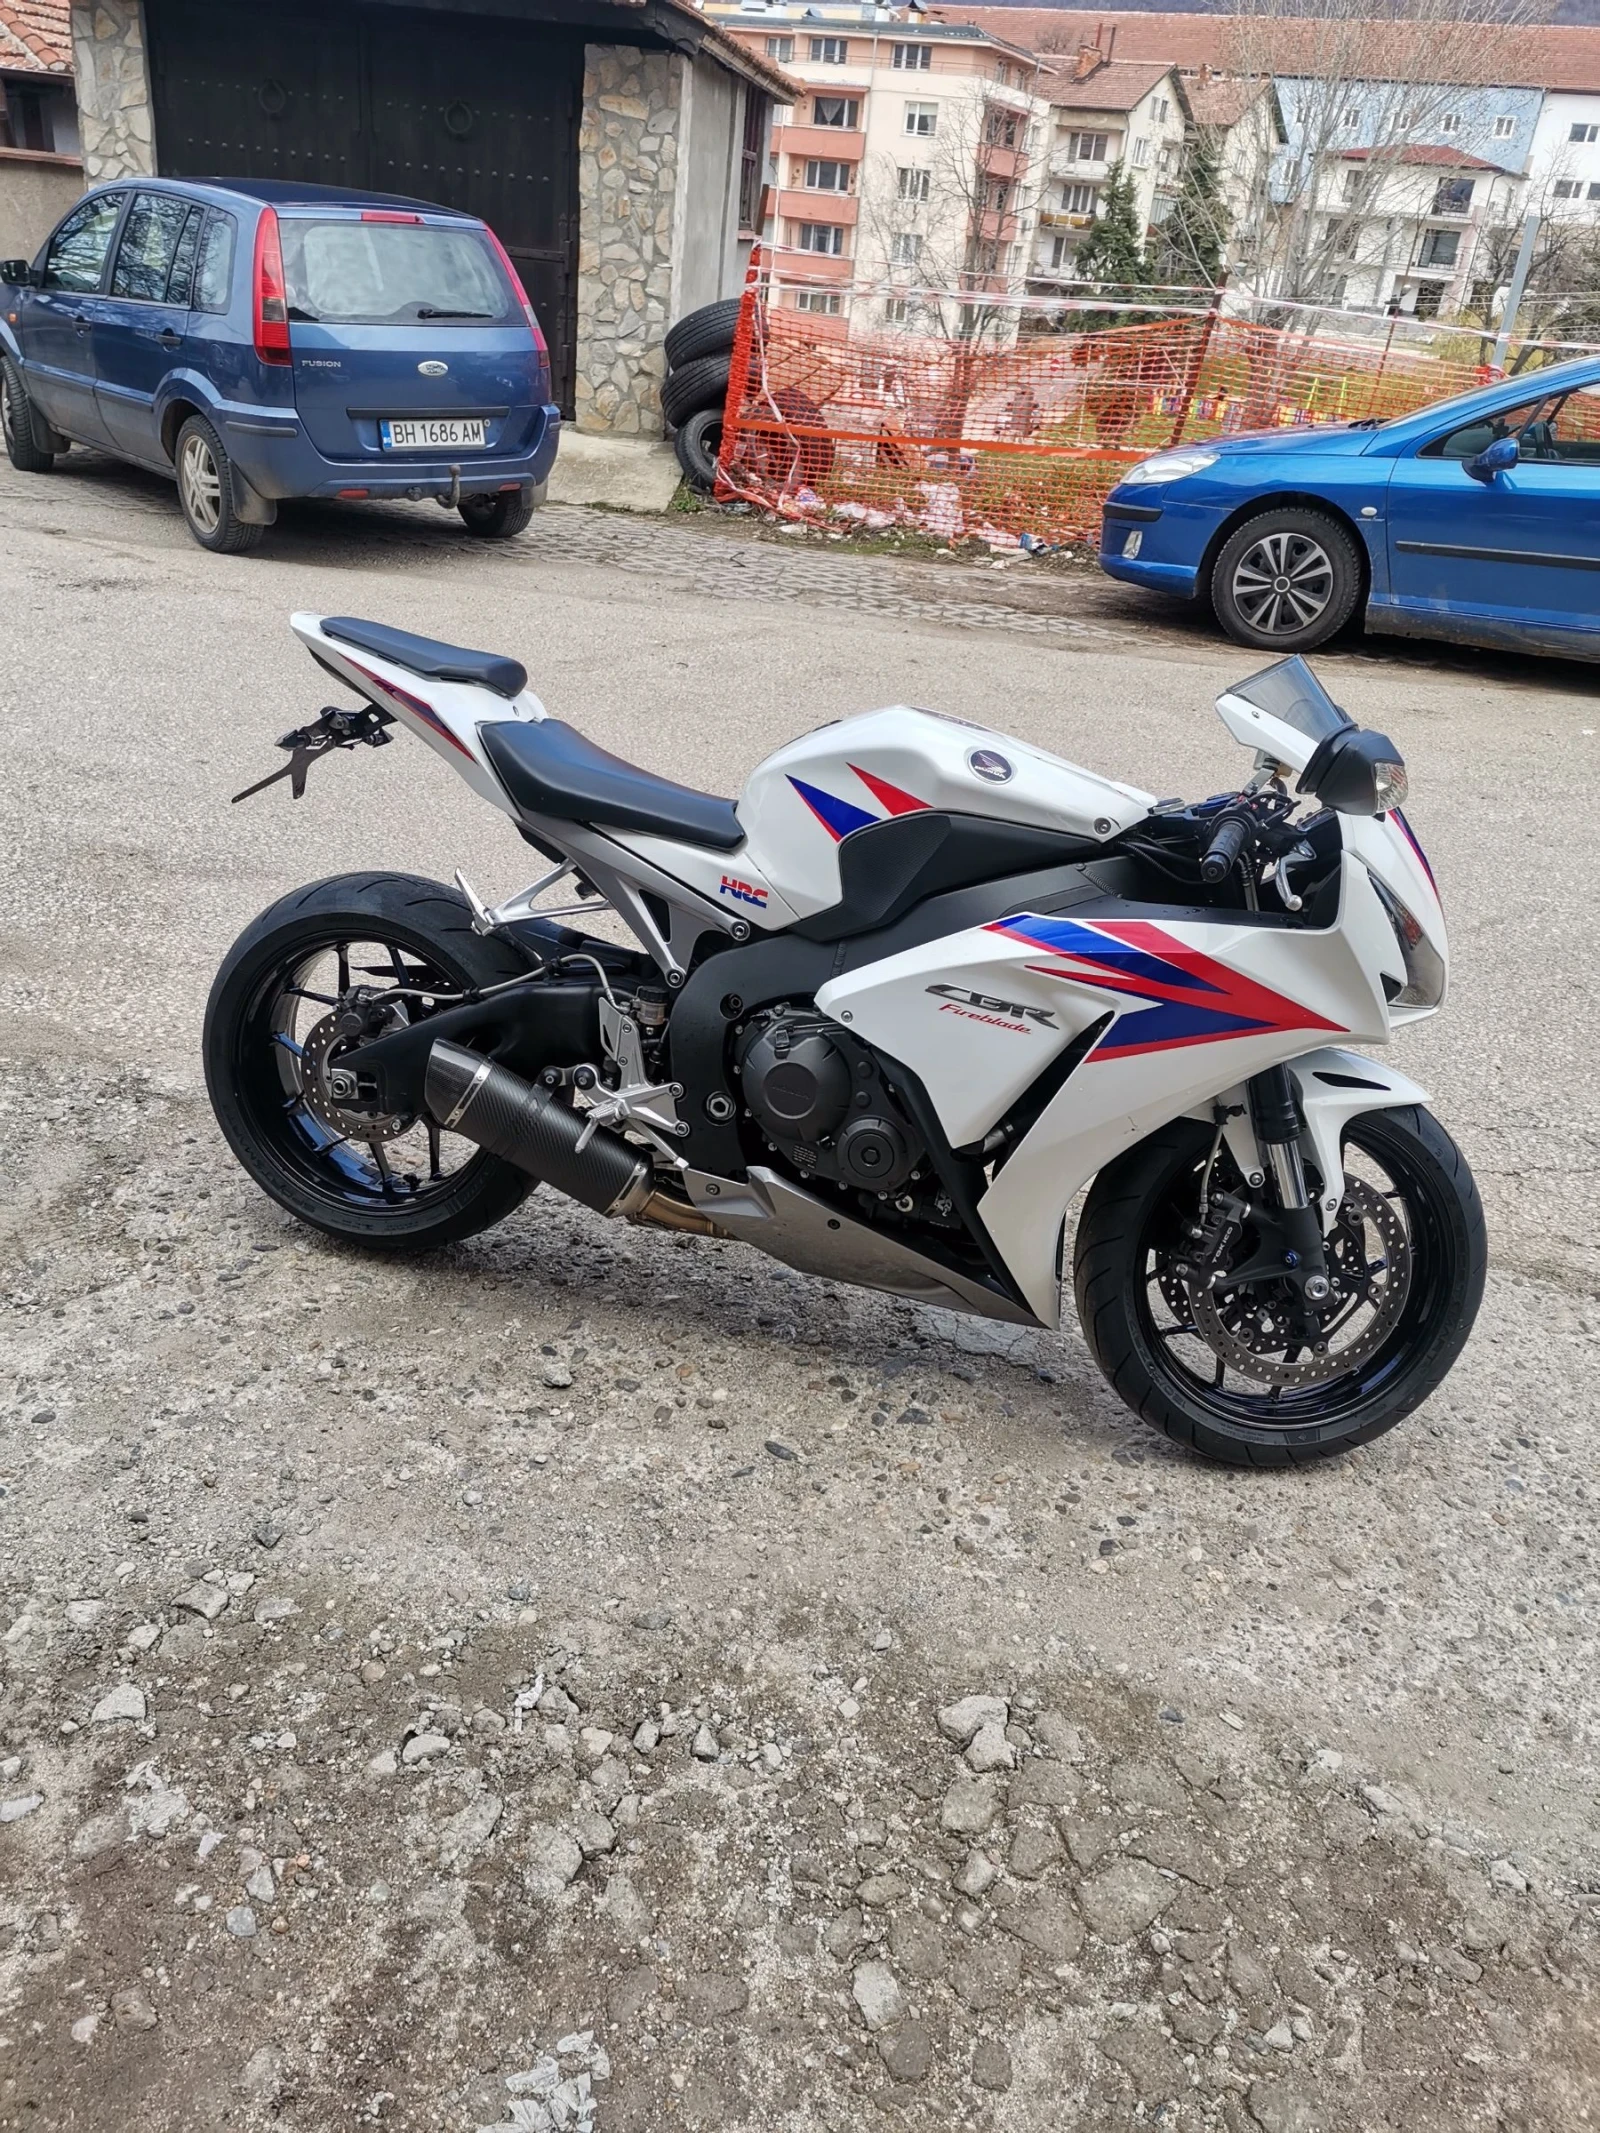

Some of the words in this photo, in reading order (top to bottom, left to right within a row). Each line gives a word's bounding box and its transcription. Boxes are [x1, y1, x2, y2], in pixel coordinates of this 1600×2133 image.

[301, 359, 342, 368] FUSION
[392, 424, 416, 444] BH
[420, 422, 458, 444] 1686
[462, 421, 482, 443] AM
[719, 875, 769, 909] HRC
[924, 982, 1060, 1030] CBR
[938, 1003, 1031, 1034] Fireblade
[1211, 1226, 1233, 1264] TOKICO
